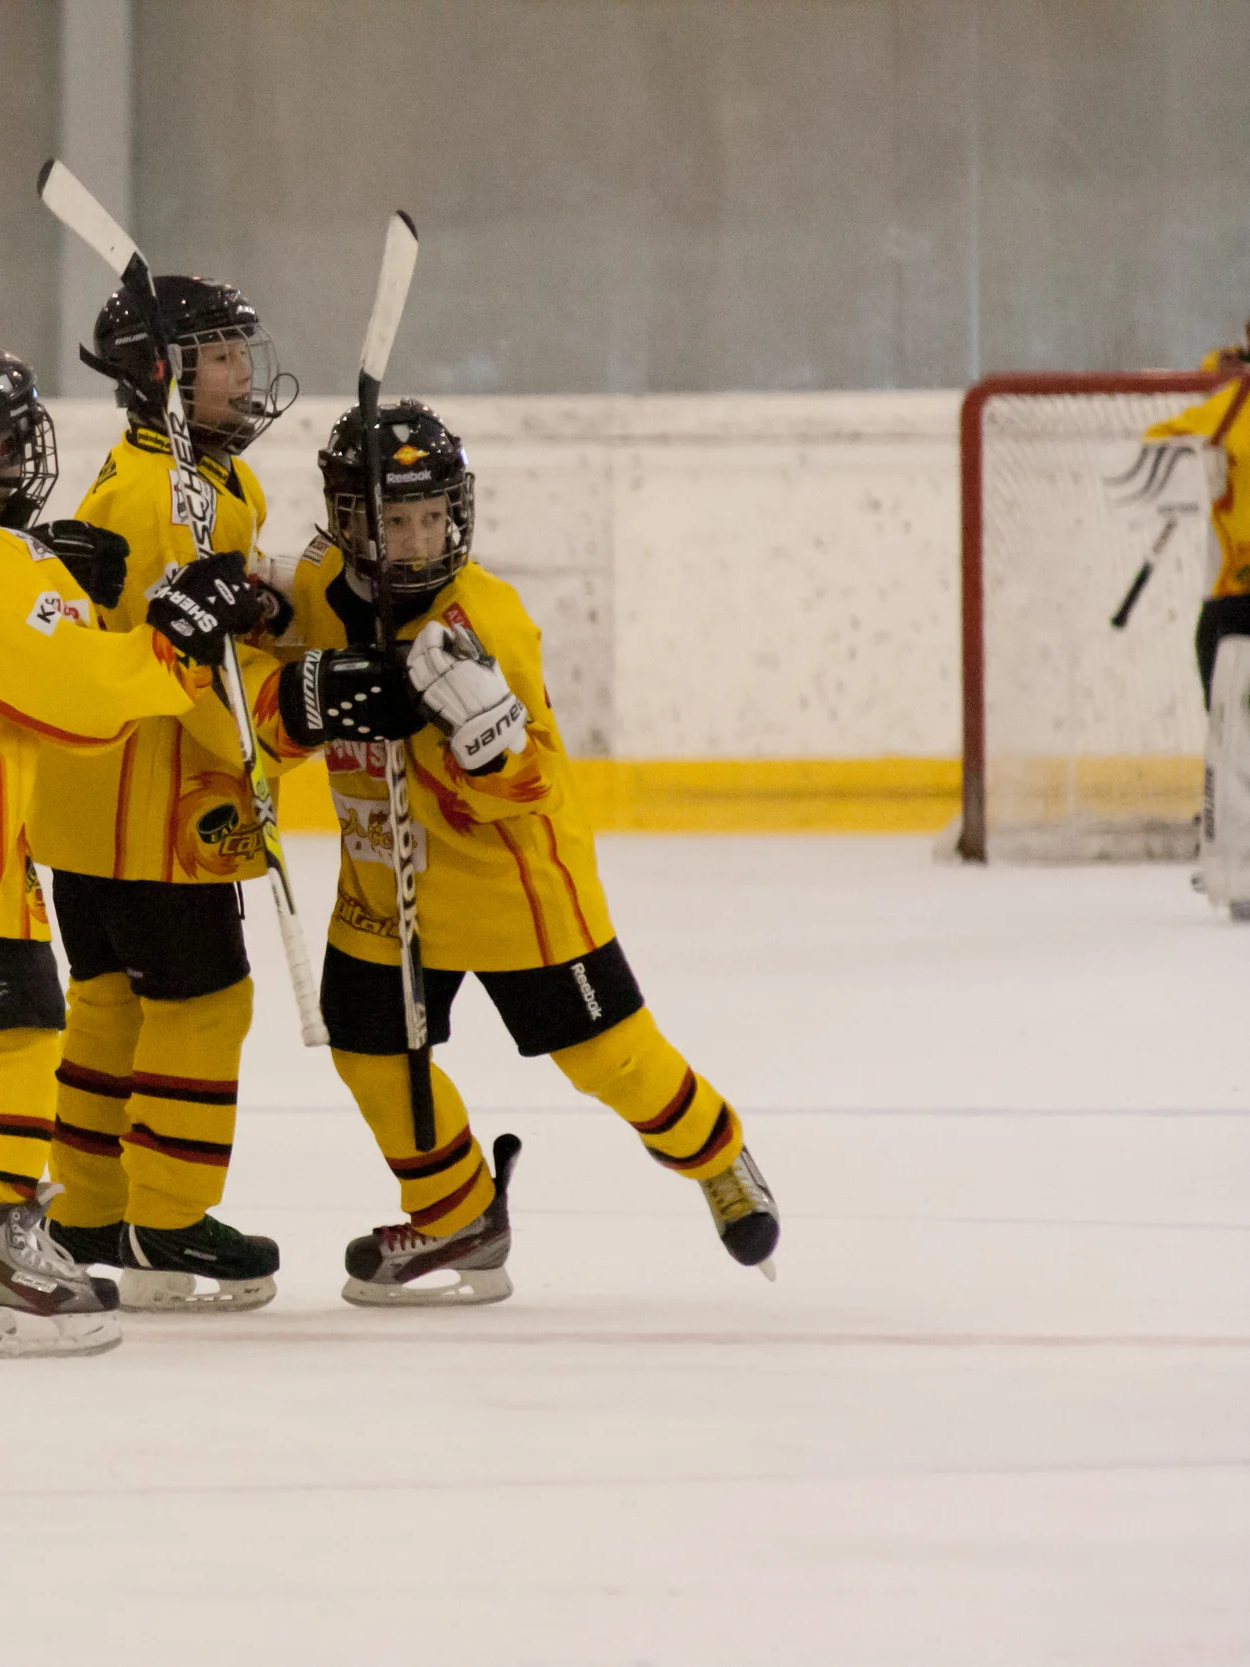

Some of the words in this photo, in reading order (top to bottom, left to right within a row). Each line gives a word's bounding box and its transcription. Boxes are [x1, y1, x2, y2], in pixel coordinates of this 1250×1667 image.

[169, 411, 217, 561] ISCHER
[386, 470, 431, 484] Reebok
[570, 961, 603, 1022] Reebok
